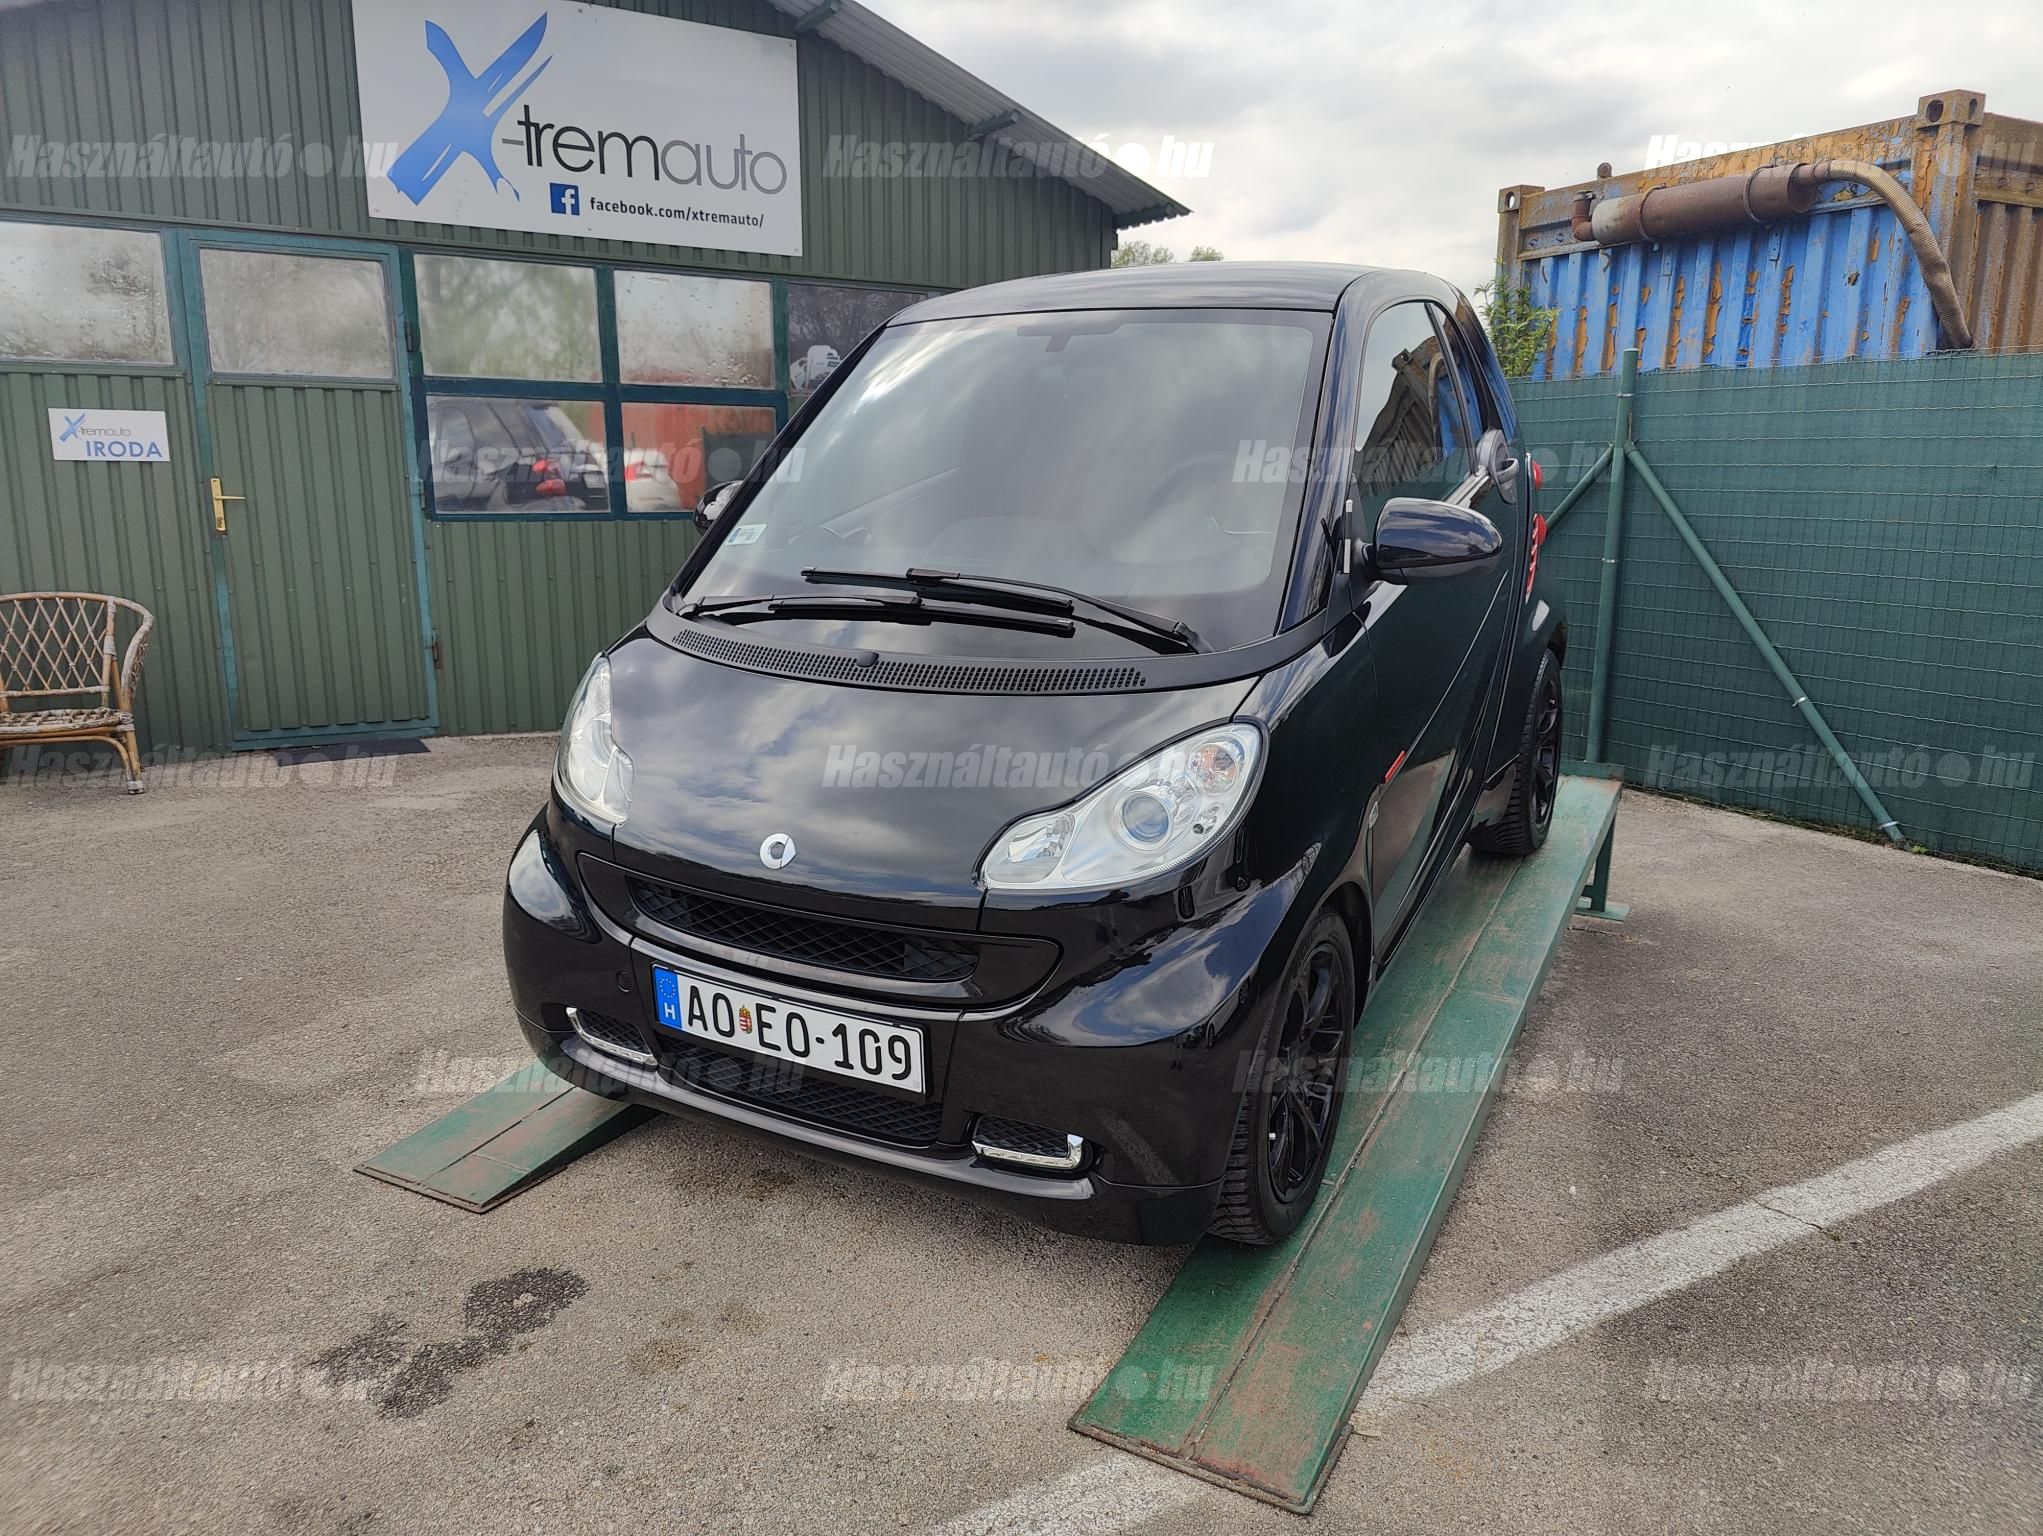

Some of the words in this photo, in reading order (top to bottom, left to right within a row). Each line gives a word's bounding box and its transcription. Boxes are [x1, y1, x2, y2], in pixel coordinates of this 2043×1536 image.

[590, 197, 764, 229] facebook.com/xtremauto/
[85, 440, 163, 458] IRODA
[664, 1001, 677, 1021] H
